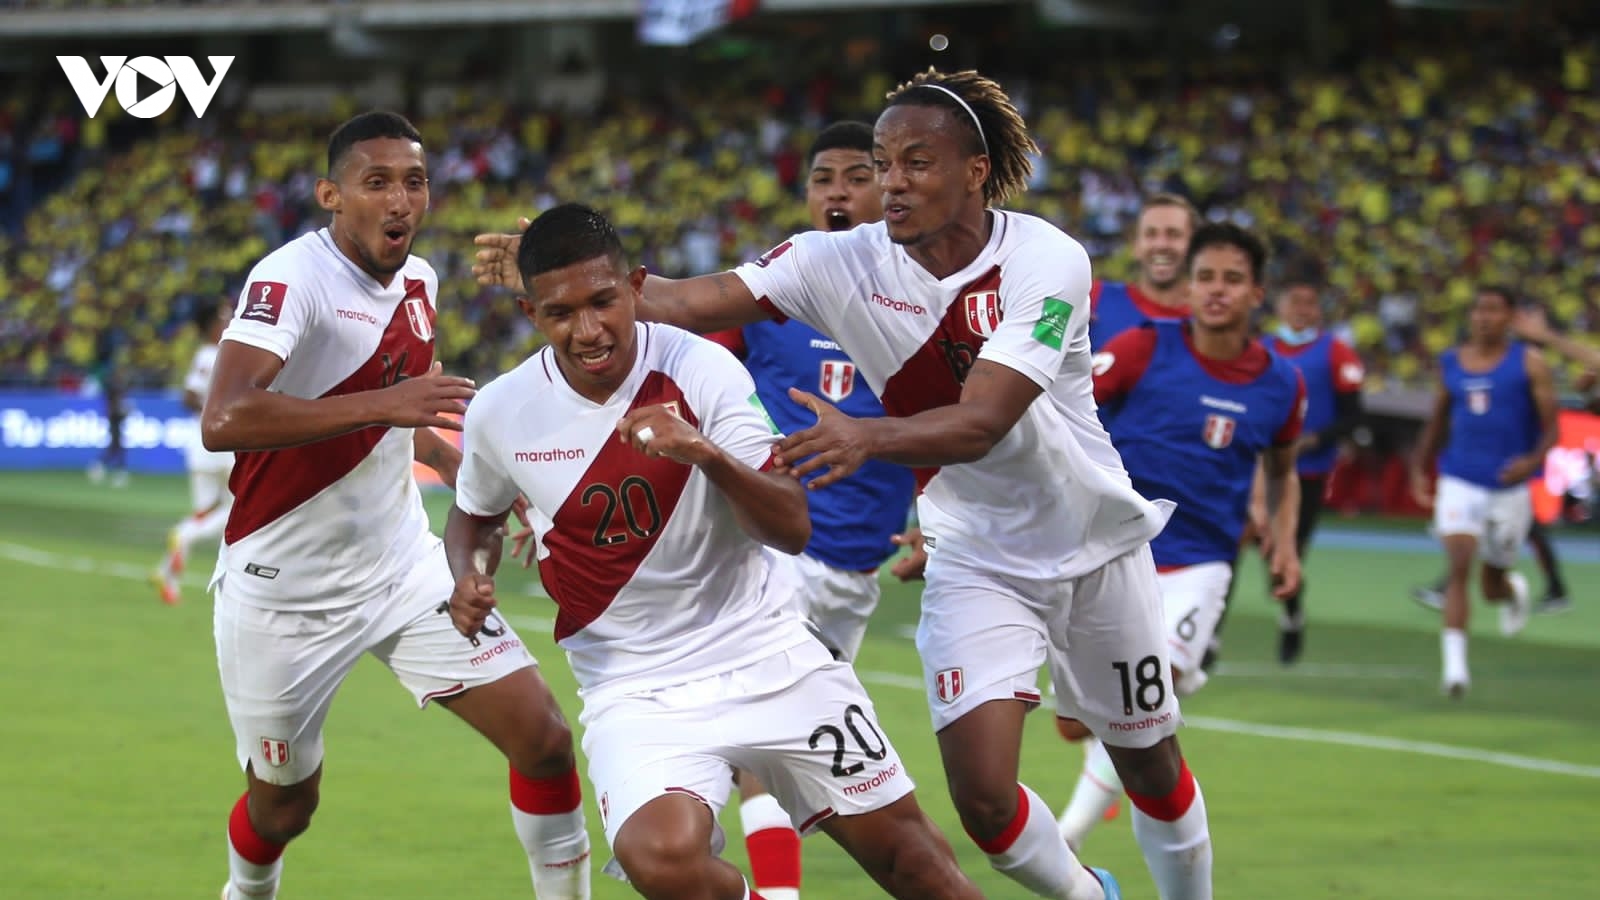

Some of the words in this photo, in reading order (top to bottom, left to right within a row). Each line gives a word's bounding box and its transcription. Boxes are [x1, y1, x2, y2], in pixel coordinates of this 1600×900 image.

[514, 447, 586, 463] marathon
[581, 475, 662, 547] 20
[1176, 606, 1200, 642] 6
[1112, 655, 1166, 716] 18
[1108, 711, 1173, 733] marathon
[808, 704, 887, 778] 20
[842, 763, 899, 797] marathon
